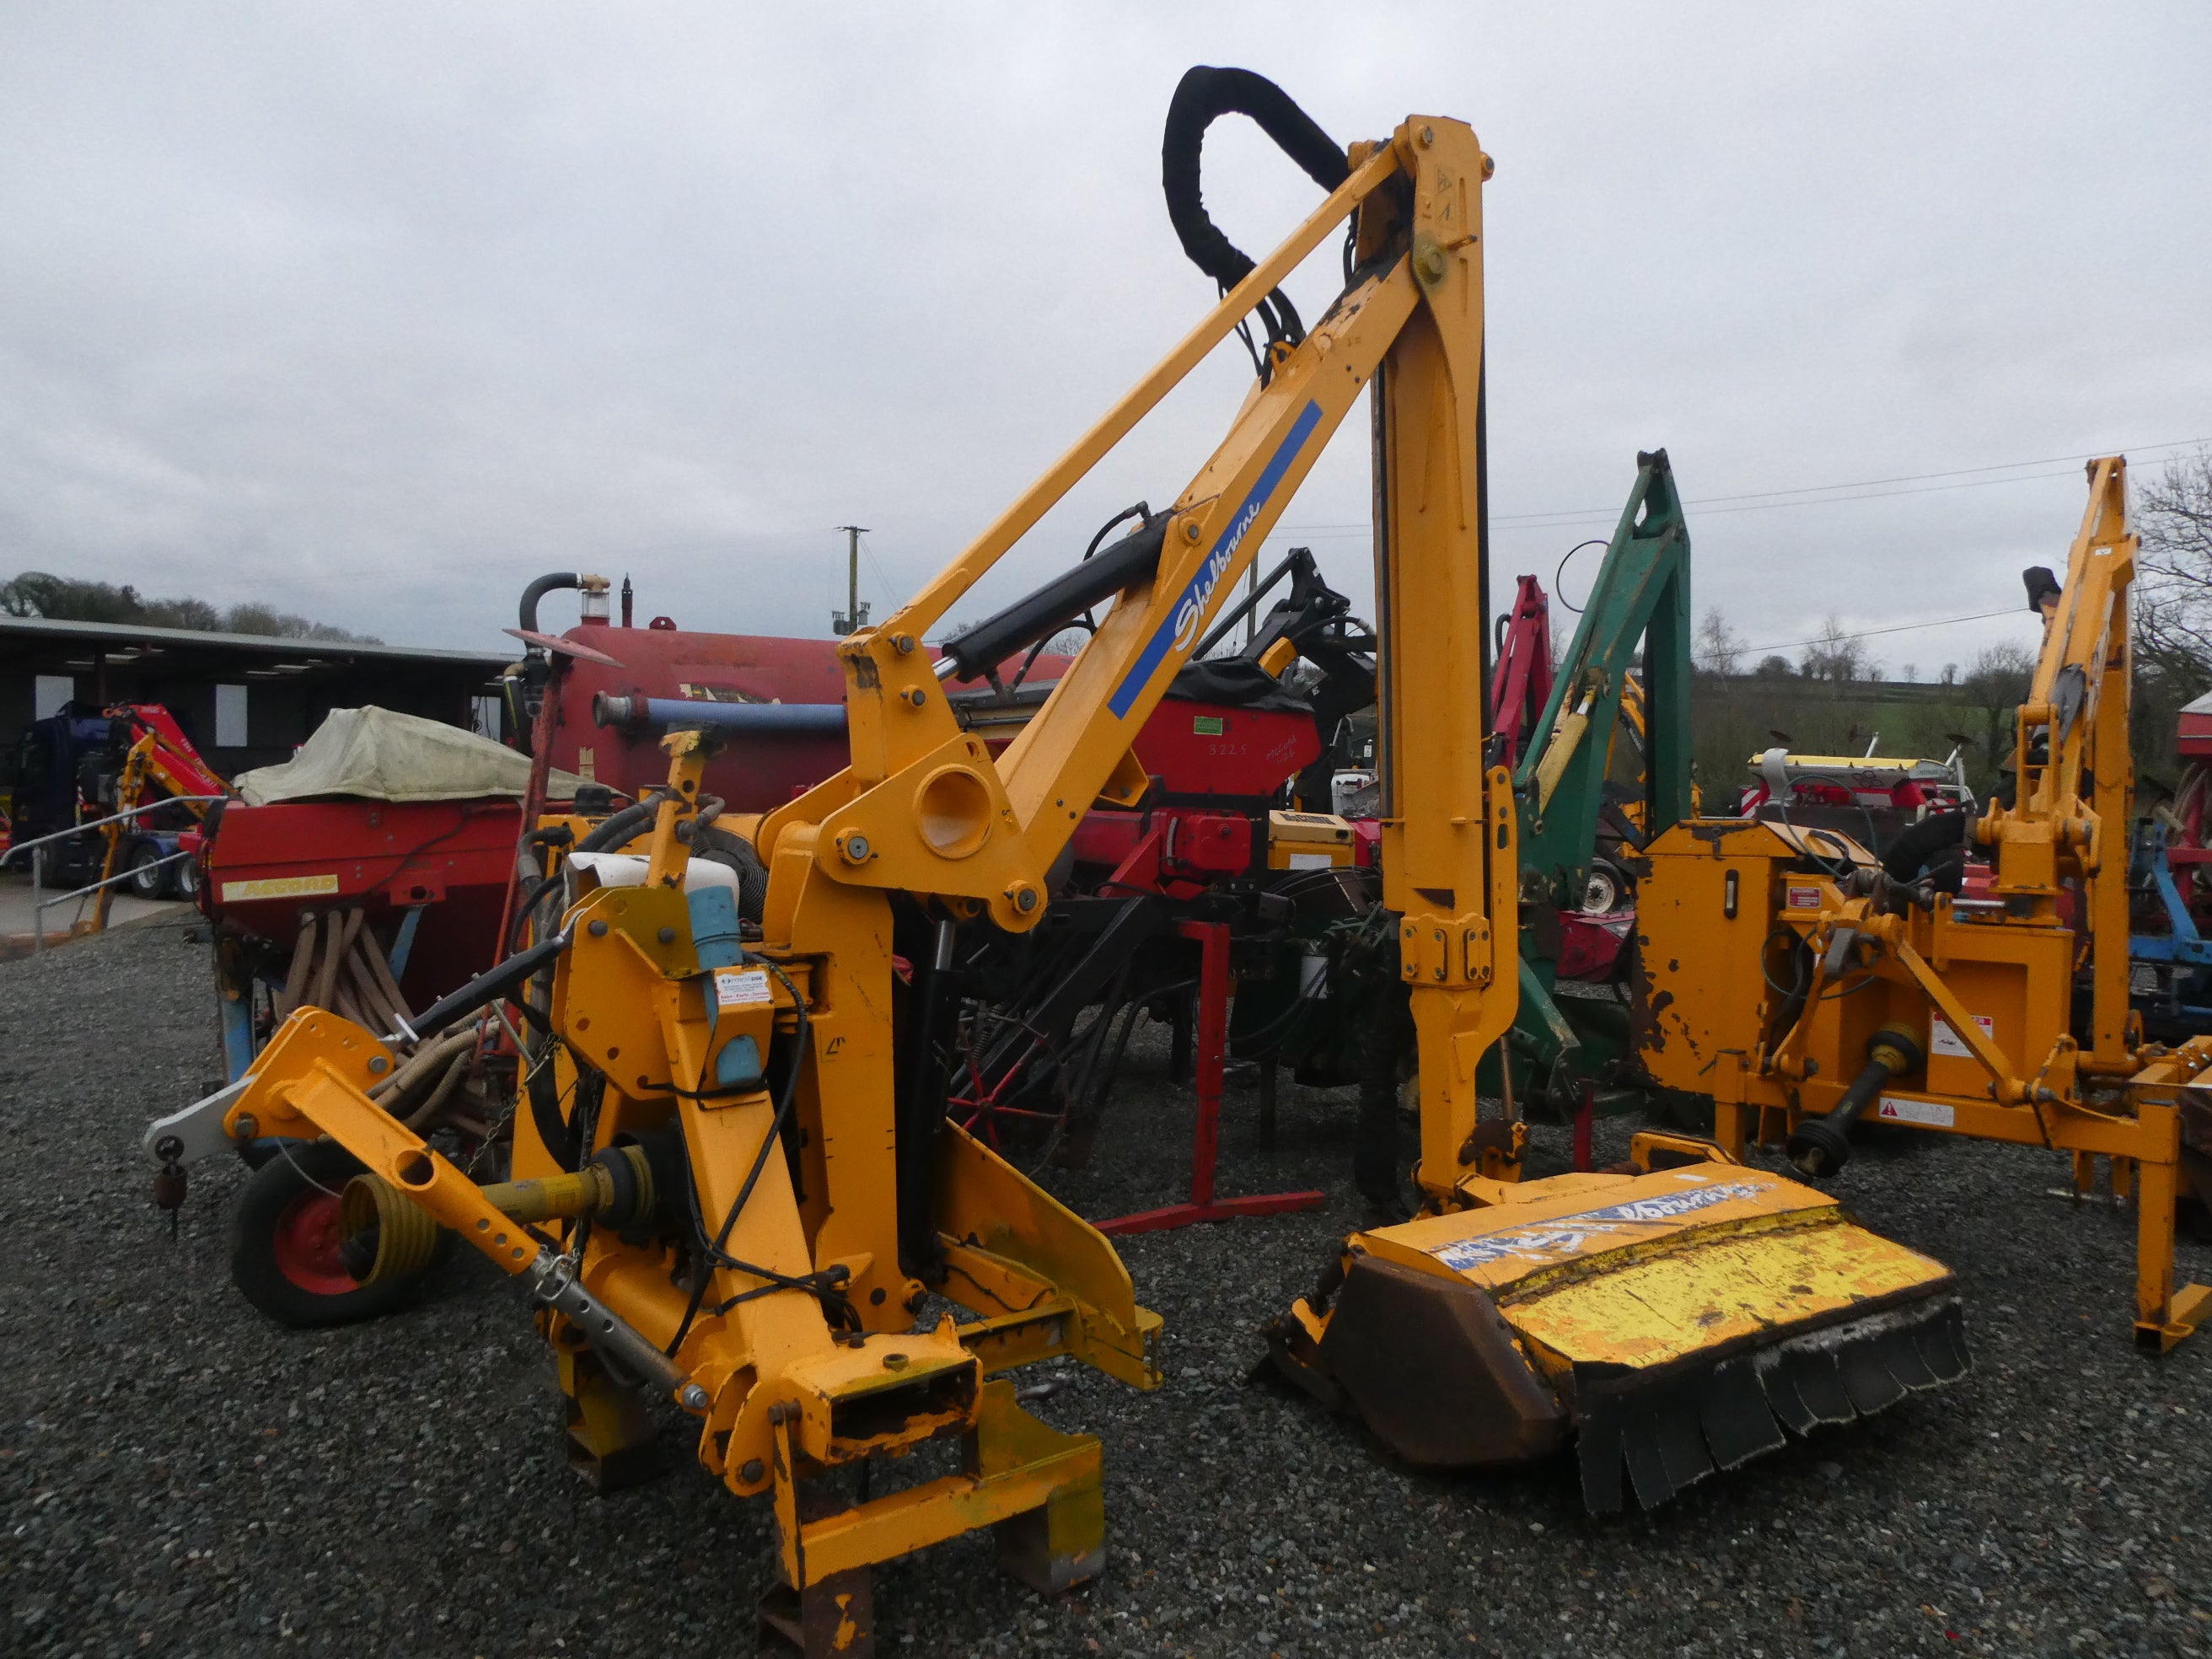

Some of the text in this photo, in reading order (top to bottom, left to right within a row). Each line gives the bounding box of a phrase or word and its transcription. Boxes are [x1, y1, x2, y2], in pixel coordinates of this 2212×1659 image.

[1174, 502, 1260, 652] Shelbourne
[1209, 744, 1248, 755] 3225
[242, 876, 337, 897] ACCORD
